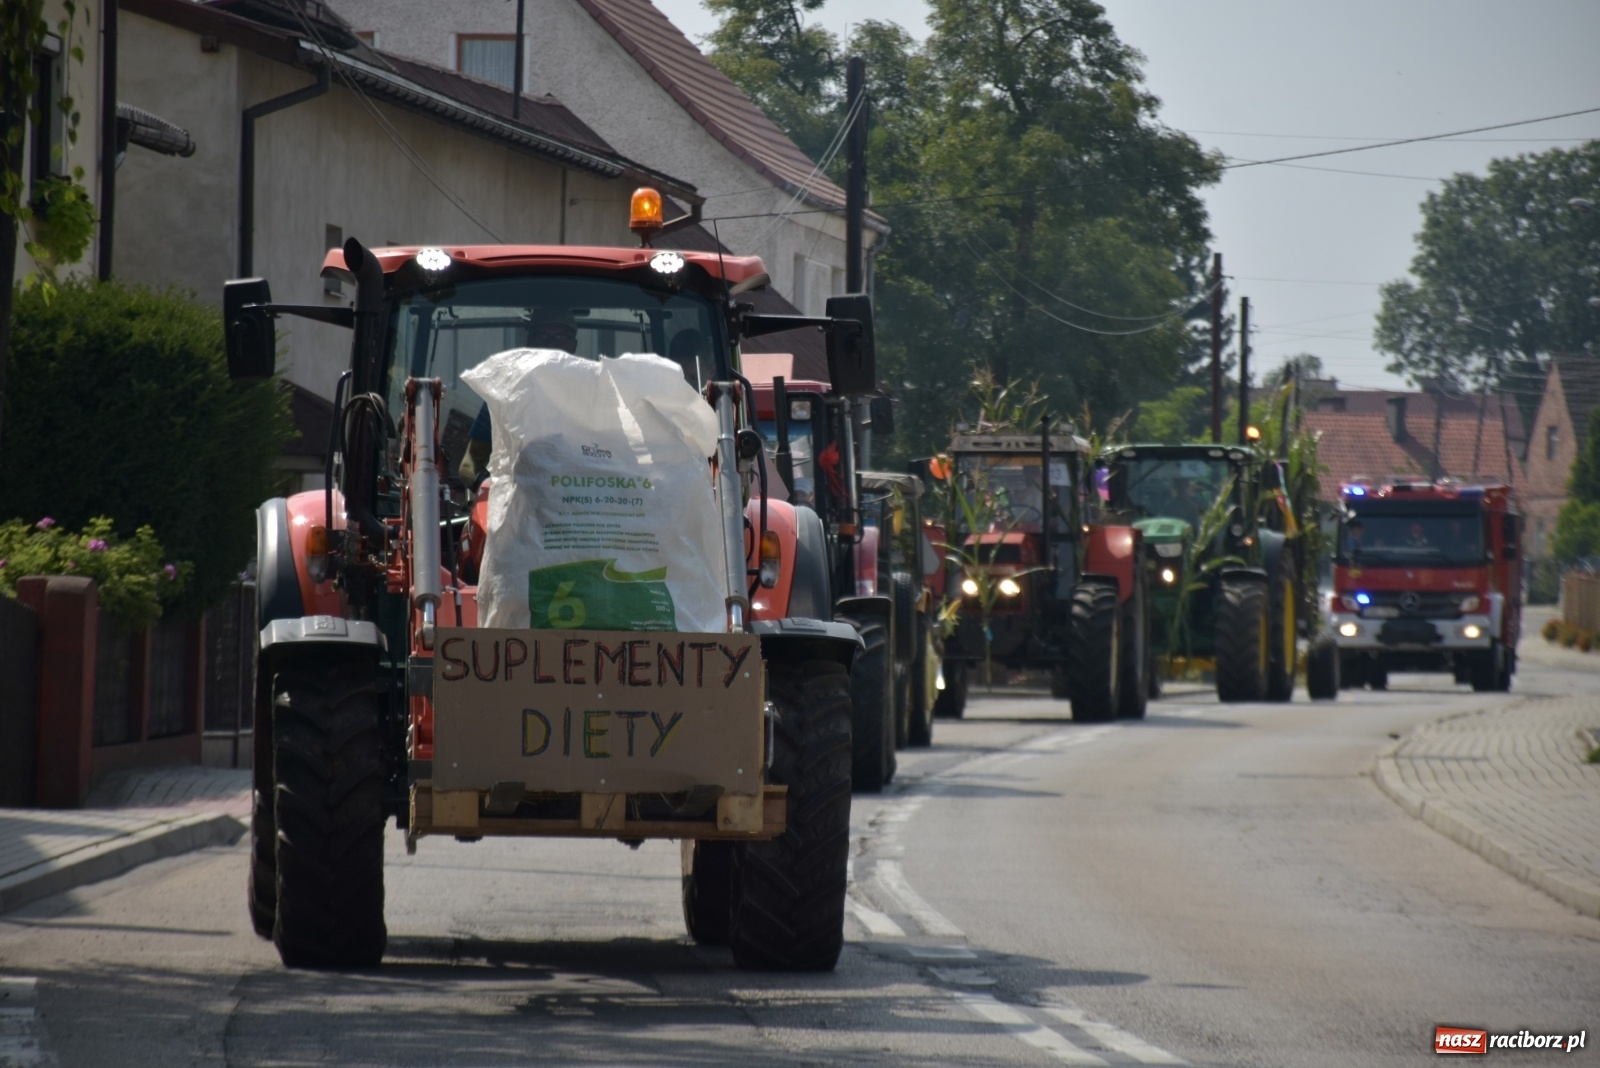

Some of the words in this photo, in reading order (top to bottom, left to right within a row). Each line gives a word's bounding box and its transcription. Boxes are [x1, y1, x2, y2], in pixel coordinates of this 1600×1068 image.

[562, 496, 592, 505] NPK(S)
[595, 496, 643, 506] 6-20-30-(7)
[642, 478, 652, 489] 6
[548, 581, 586, 628] 6
[441, 637, 752, 688] SUPLEMENTY
[522, 707, 684, 759] DIETY
